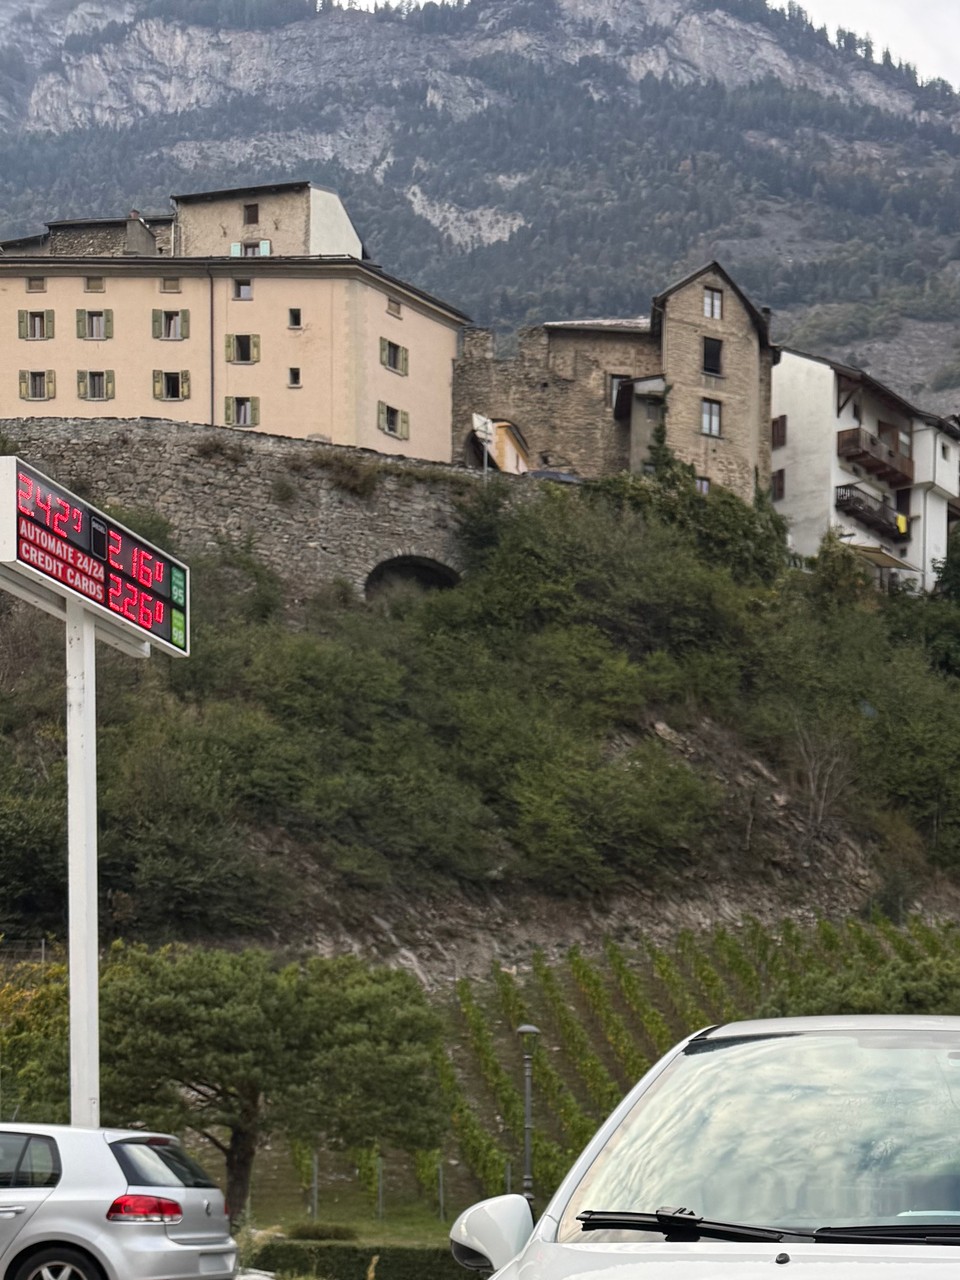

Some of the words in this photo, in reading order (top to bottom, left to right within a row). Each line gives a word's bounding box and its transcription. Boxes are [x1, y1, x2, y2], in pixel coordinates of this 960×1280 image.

[20, 519, 75, 563] AUTOMATE
[76, 550, 105, 583] 24/24
[21, 542, 64, 578] CREDIT
[66, 568, 103, 601] CARDS
[172, 586, 185, 606] 95
